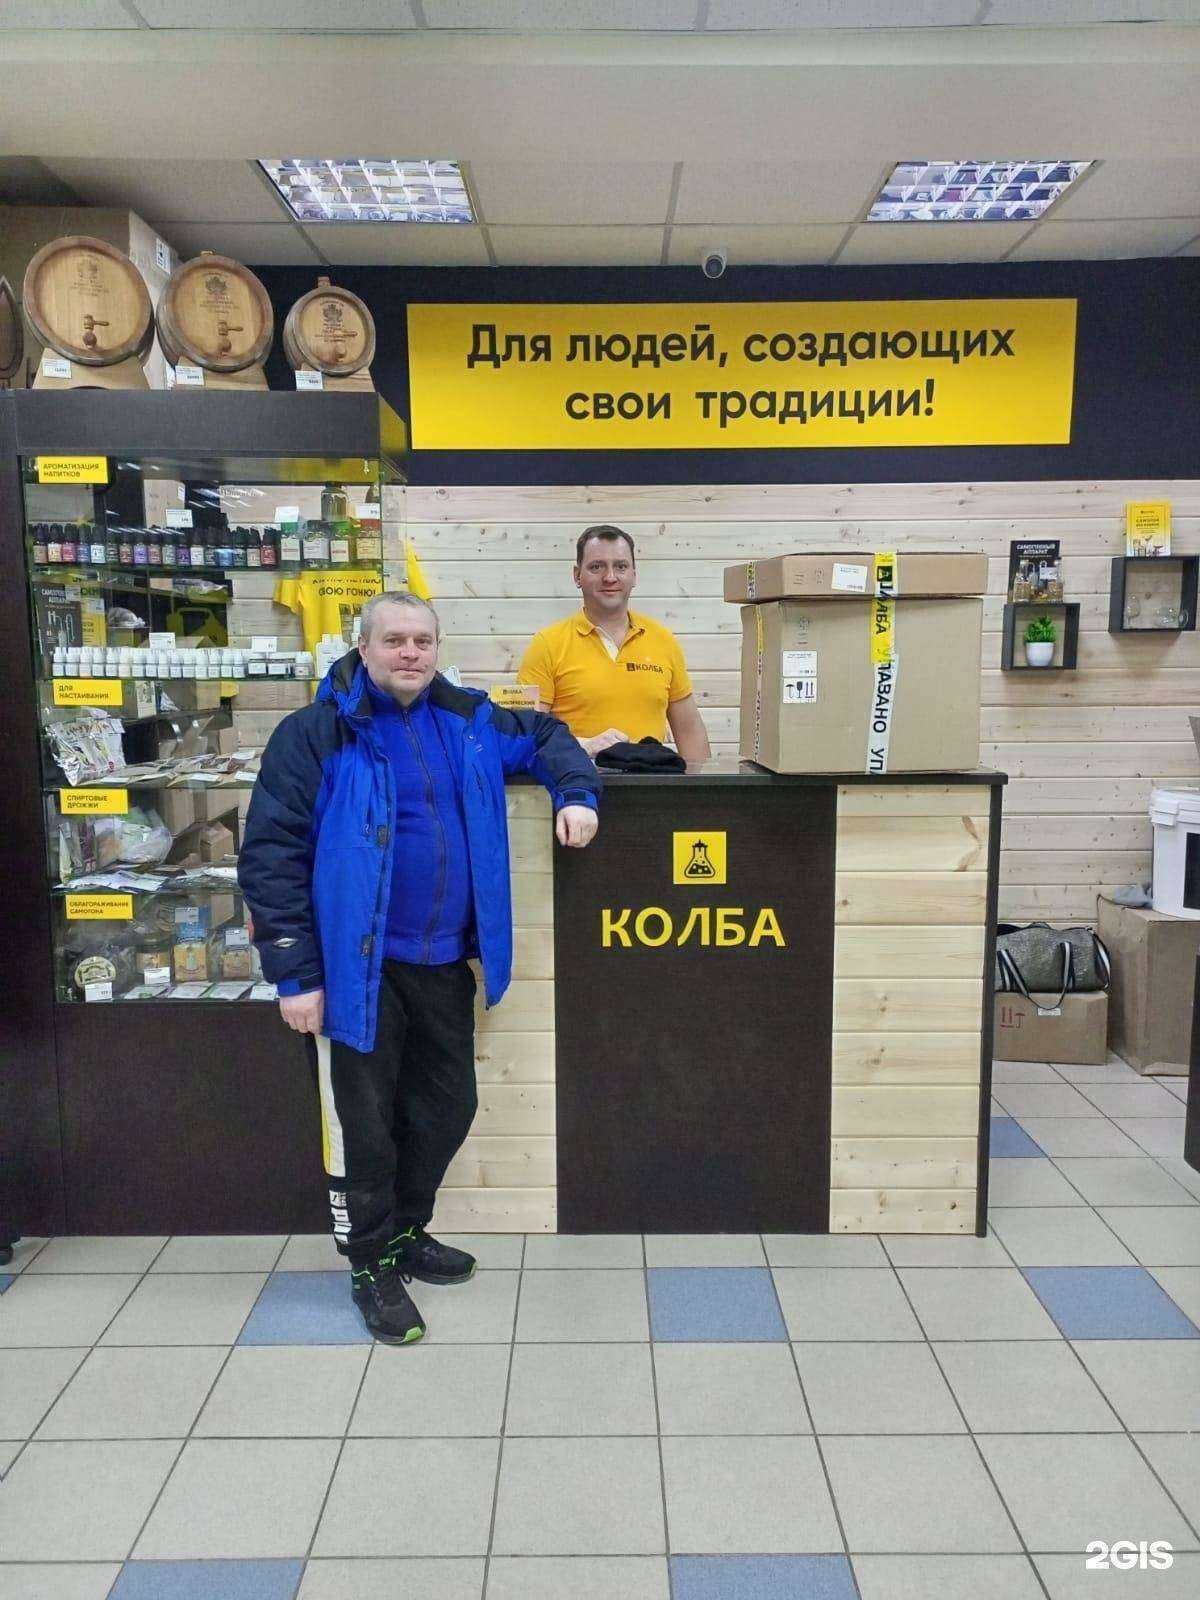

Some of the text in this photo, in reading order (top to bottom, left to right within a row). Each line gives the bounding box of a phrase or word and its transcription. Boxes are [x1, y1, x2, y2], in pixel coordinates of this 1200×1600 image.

[466, 323, 1016, 369] Для людей, создающих
[565, 378, 936, 429] свои традиции!
[43, 463, 100, 471] АРОМАТИЗАЦИЯ
[635, 664, 664, 674] КОЛБА
[58, 684, 74, 692] ДЛЯ
[58, 692, 109, 700] НАСТАИВАНИЯ
[66, 794, 108, 802] СПИРТОВЫЕ
[602, 906, 787, 947] КОЛБА
